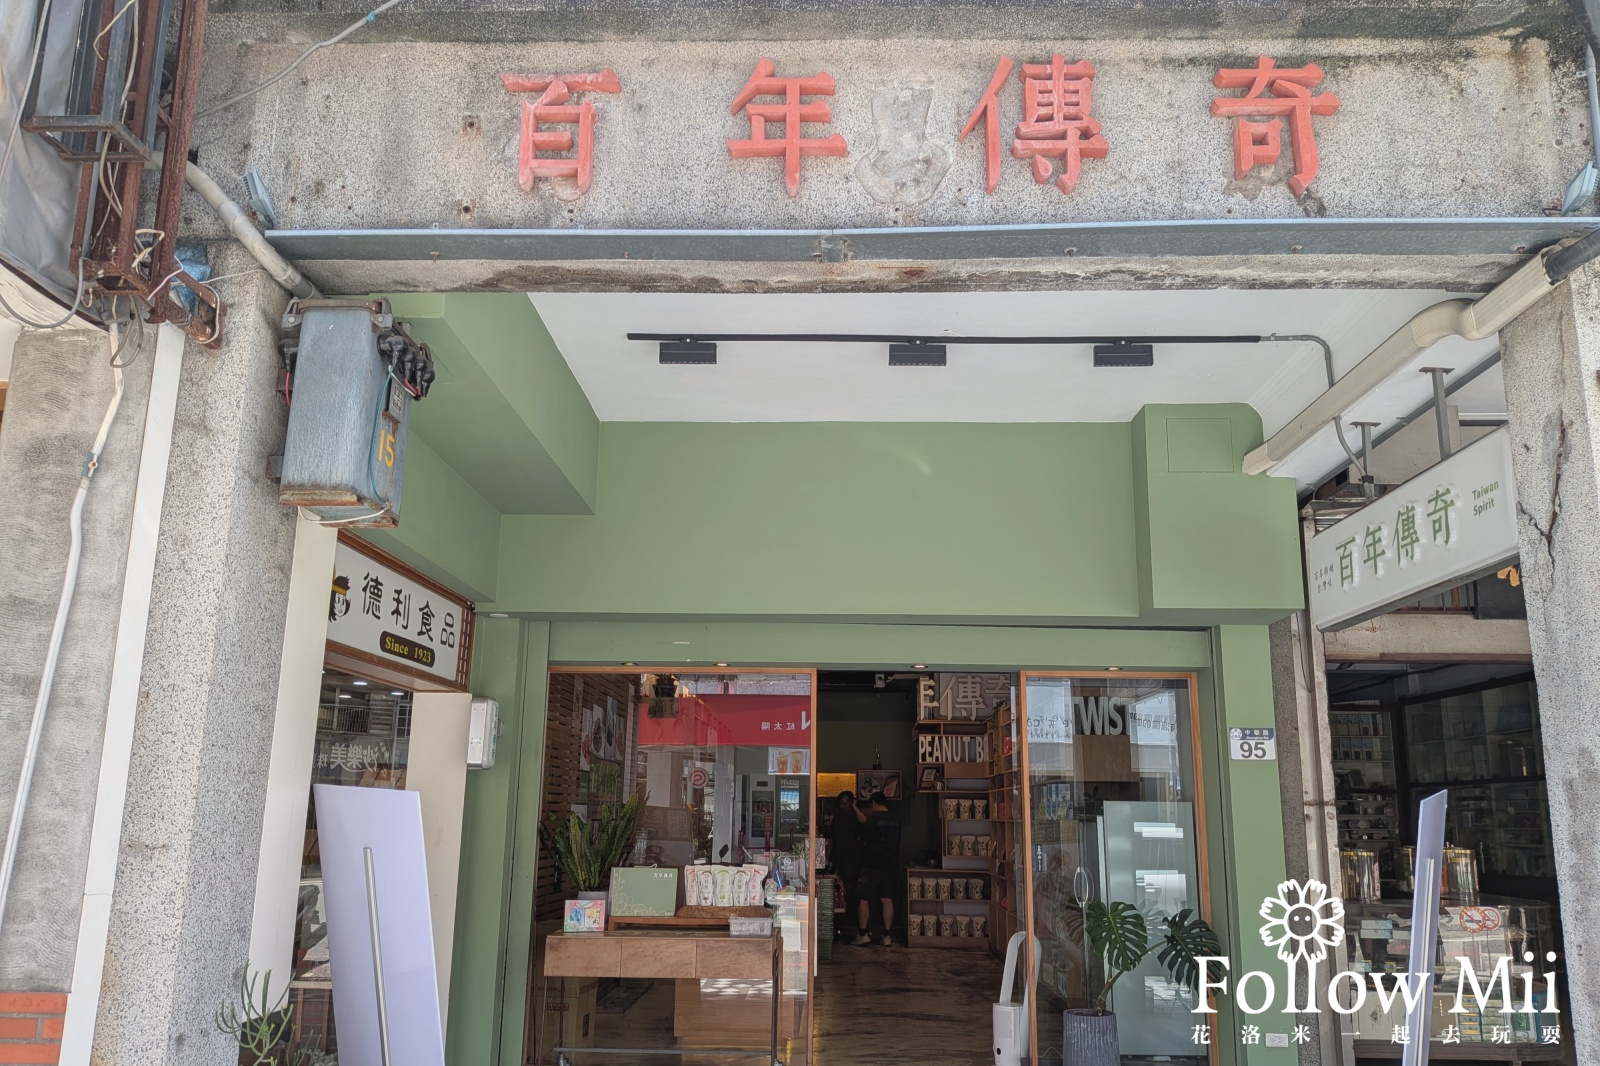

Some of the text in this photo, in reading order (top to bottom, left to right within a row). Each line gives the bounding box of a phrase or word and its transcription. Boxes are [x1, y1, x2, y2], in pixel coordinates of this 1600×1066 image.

[500, 53, 1339, 197] 百年傳奇
[378, 429, 395, 468] 15
[1472, 480, 1499, 501] Taiwan
[1473, 498, 1494, 517] Spirit
[1336, 487, 1455, 588] 百年傳奇
[361, 571, 456, 649] 德利食品
[385, 636, 432, 663] Since 1923
[918, 736, 971, 764] PEANUT
[1239, 741, 1267, 759] 95
